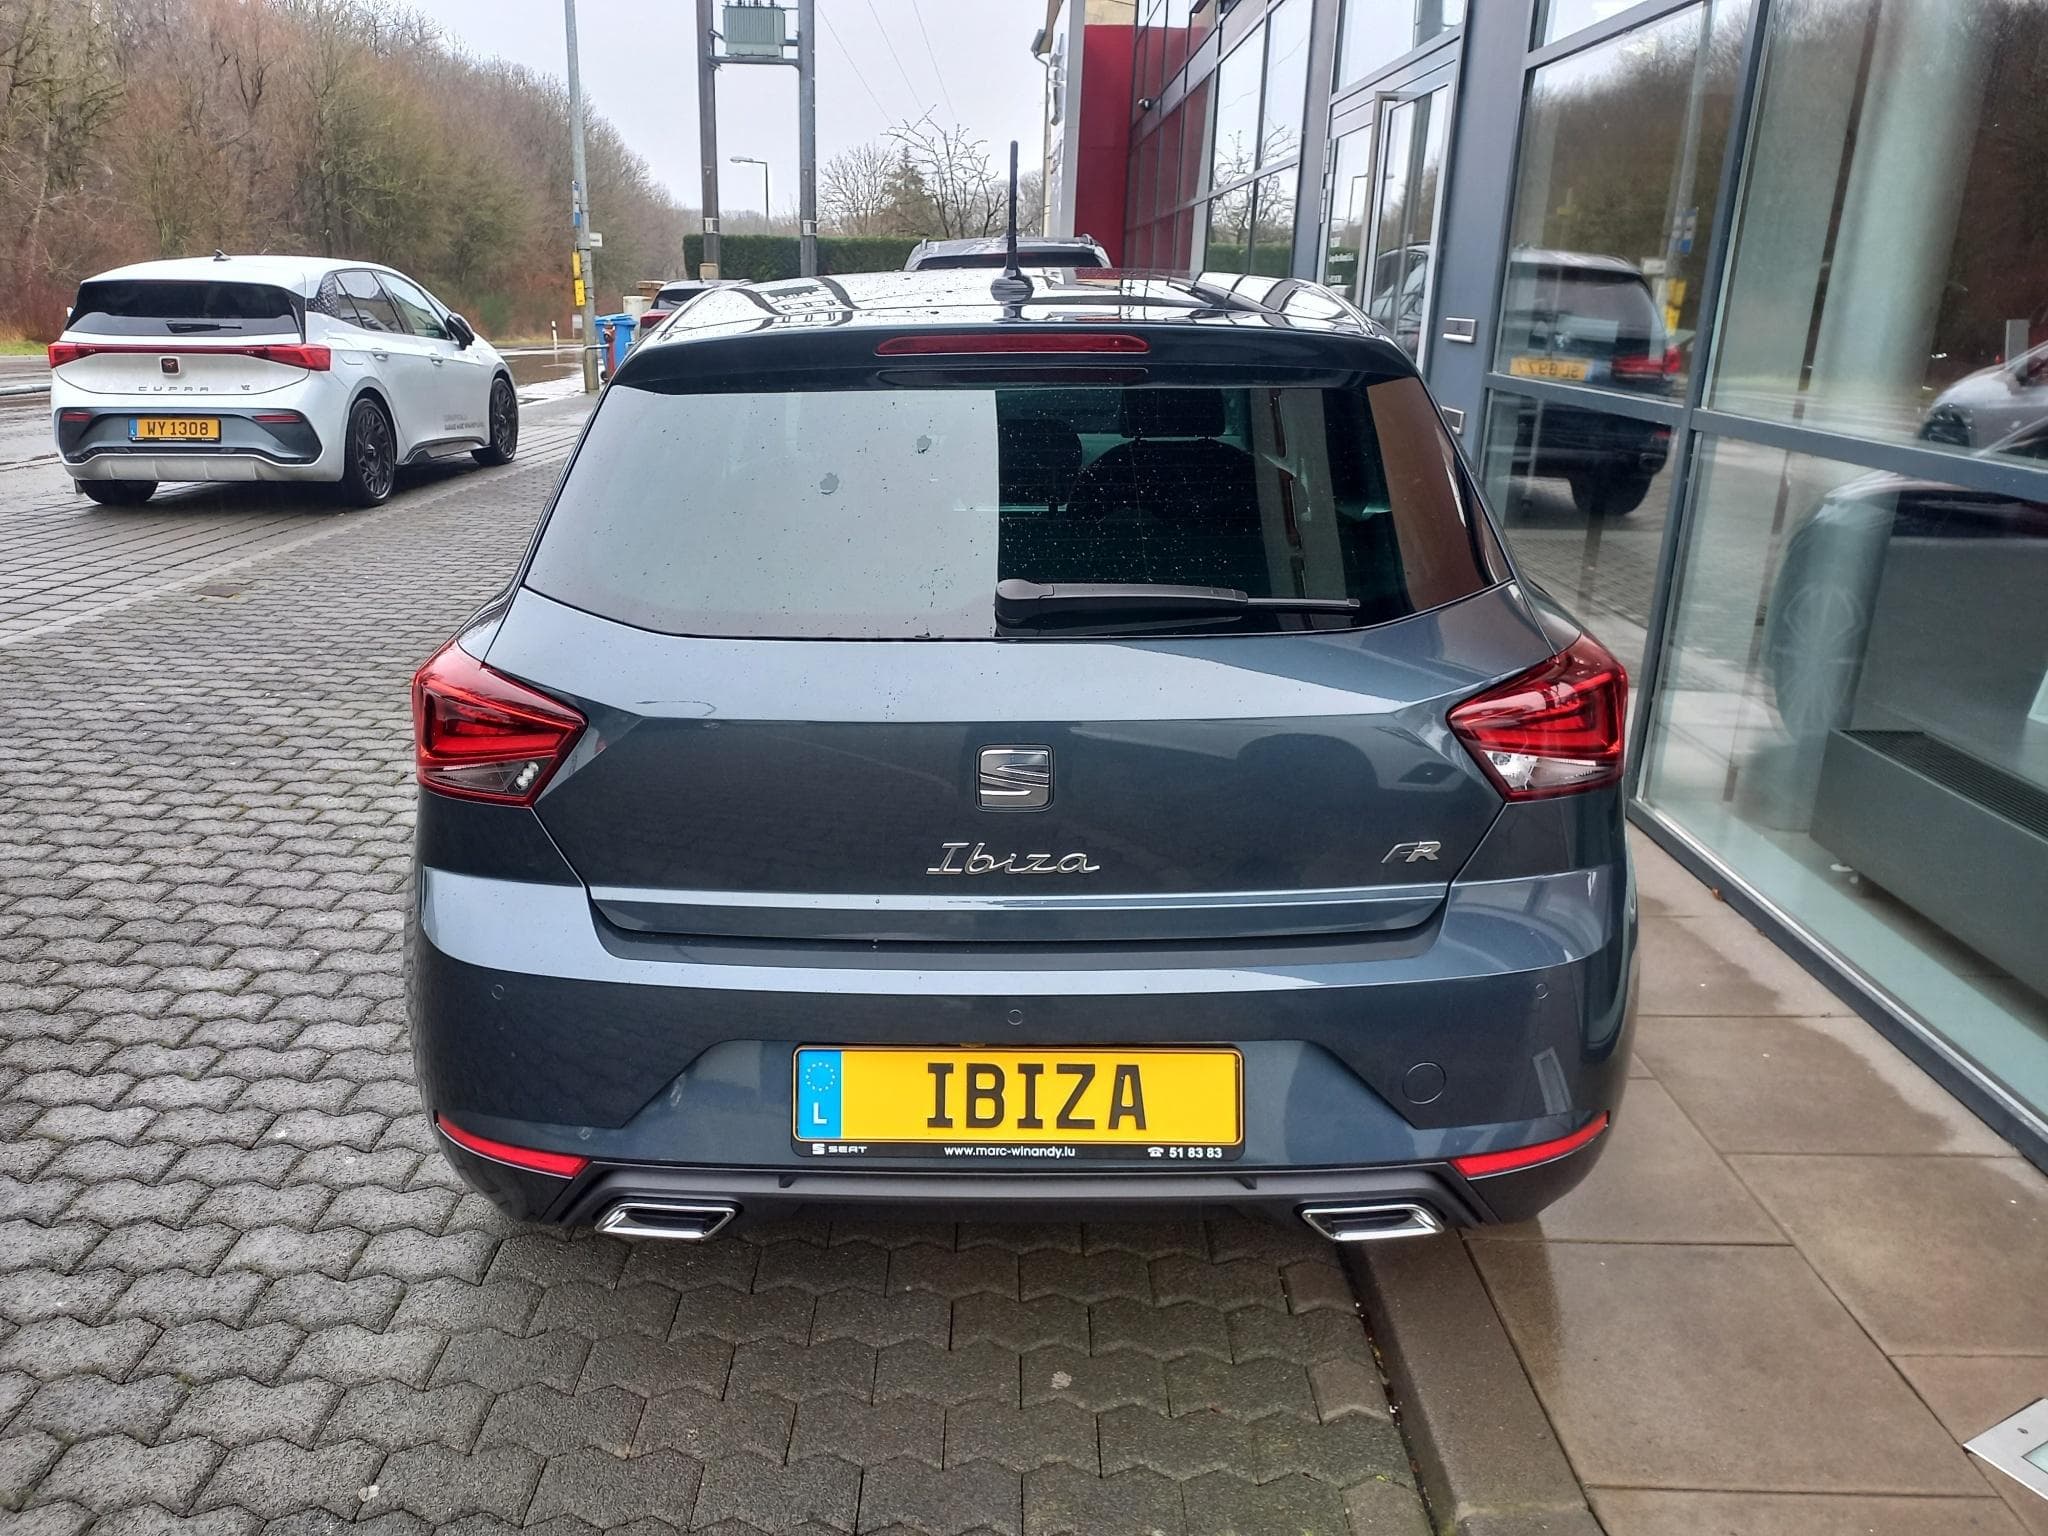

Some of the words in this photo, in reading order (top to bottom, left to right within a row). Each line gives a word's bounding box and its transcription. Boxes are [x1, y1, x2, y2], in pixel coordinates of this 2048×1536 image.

[146, 421, 166, 436] WY
[170, 421, 209, 436] 1308
[926, 842, 1100, 876] Ibiza
[1381, 840, 1442, 863] FR
[812, 1103, 828, 1125] L
[926, 1063, 1147, 1131] IBIZA
[828, 1145, 868, 1154] SEAT
[944, 1145, 1076, 1160] www.marc-winandy.lu
[1169, 1147, 1184, 1159] 51
[1187, 1147, 1204, 1159] 83
[1206, 1147, 1223, 1159] 83
